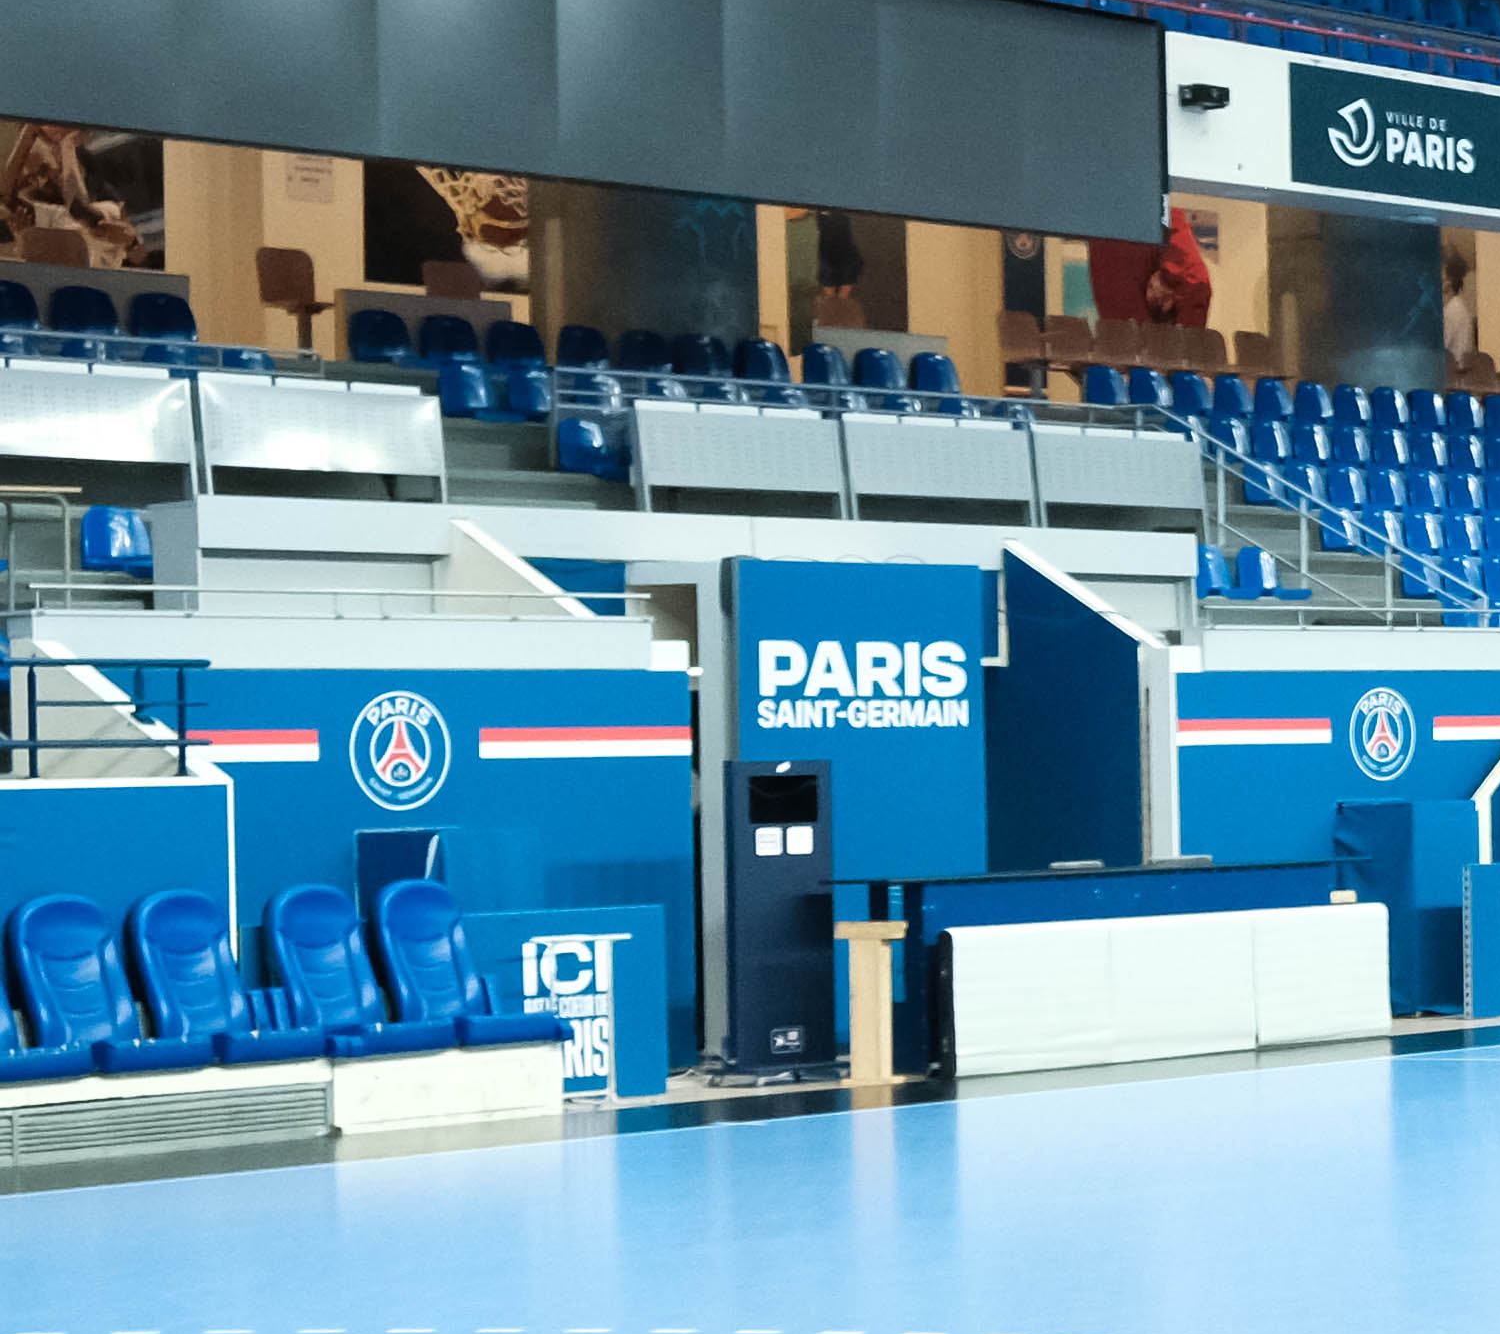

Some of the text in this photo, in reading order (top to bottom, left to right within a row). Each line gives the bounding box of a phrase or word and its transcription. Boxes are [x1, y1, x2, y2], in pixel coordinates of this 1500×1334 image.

[1385, 111, 1447, 132] VILLE DE
[1385, 128, 1477, 175] PARIS
[758, 639, 969, 698] PARIS
[366, 697, 433, 726] PARIS
[757, 698, 970, 729] SAINT-GERMAIN
[1360, 692, 1404, 716] PARIS
[522, 940, 609, 997] ICI
